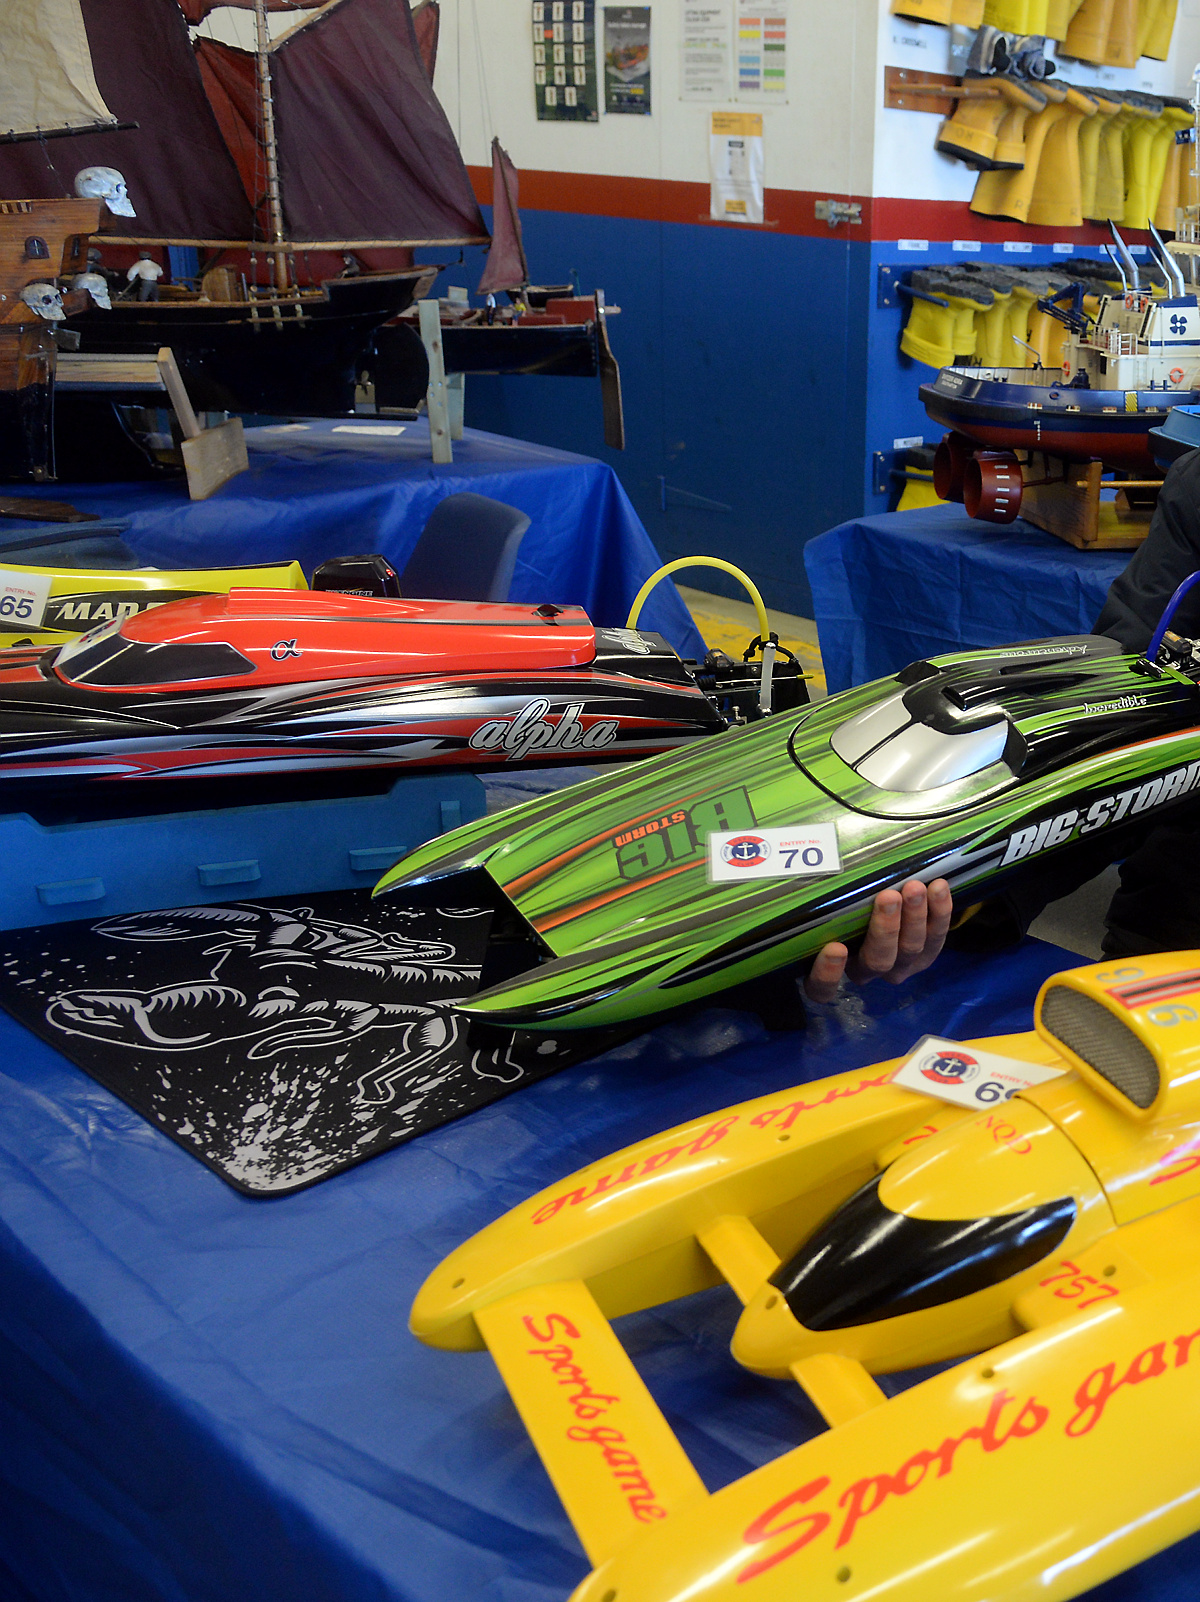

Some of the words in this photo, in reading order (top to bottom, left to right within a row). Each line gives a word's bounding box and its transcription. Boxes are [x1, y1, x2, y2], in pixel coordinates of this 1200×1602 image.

[0, 595, 35, 619] 65
[5, 586, 27, 595] ENTRY
[1083, 695, 1147, 715] Incredible
[468, 697, 620, 762] alpha
[614, 811, 686, 848] STORM
[779, 847, 824, 869] 70
[975, 1115, 1033, 1155] NQD
[530, 1115, 740, 1226] game
[1039, 1260, 1120, 1310] 757
[522, 1313, 621, 1421] Sports
[566, 1425, 668, 1524] game
[736, 1388, 1050, 1586] Sports
